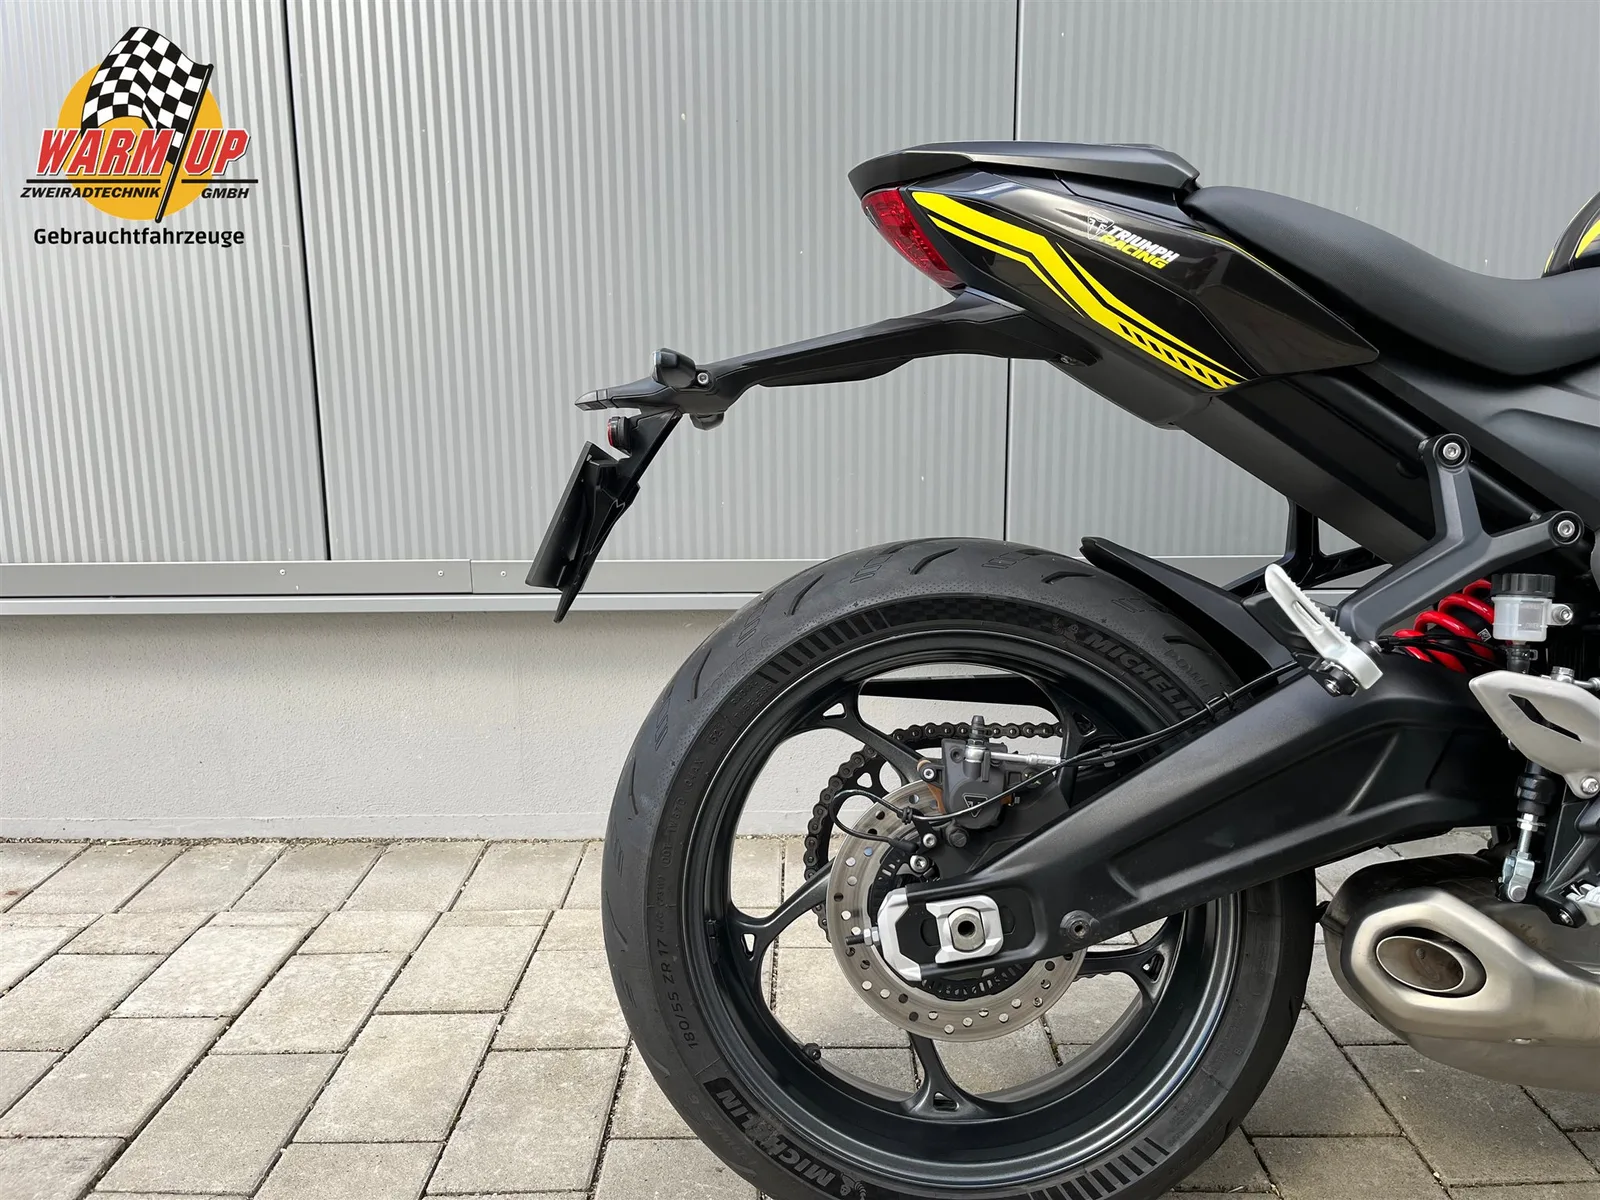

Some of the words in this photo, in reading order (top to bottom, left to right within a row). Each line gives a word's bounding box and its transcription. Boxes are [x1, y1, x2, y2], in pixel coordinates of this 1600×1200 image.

[1100, 234, 1170, 270] RACING
[1106, 225, 1180, 263] TRIUMPH
[656, 938, 669, 961] 17
[661, 961, 676, 985] ZR
[668, 991, 699, 1048] 180/55
